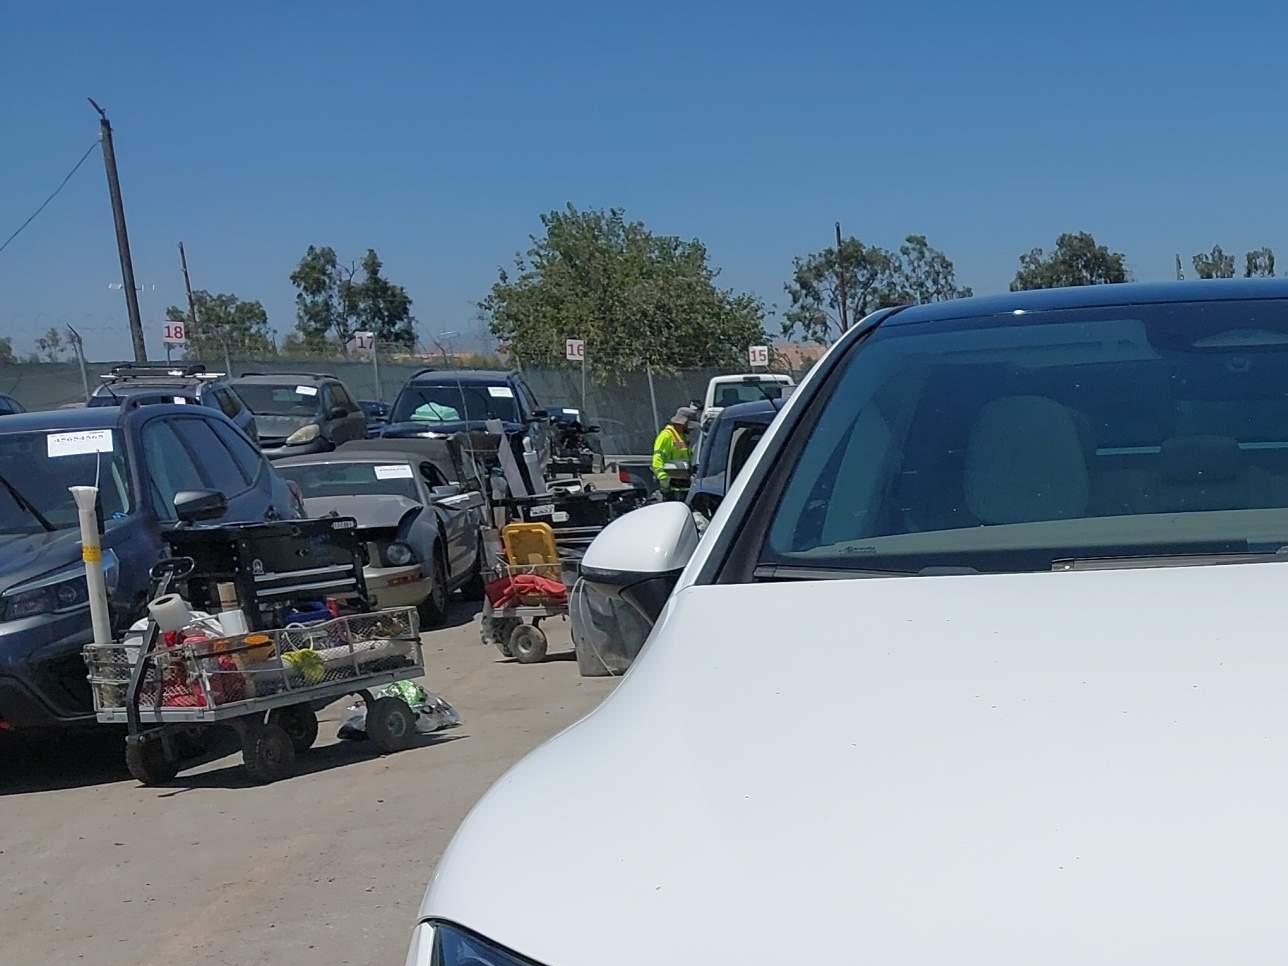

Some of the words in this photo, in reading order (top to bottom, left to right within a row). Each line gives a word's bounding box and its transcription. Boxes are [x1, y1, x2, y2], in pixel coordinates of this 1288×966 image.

[164, 324, 183, 339] 18
[357, 335, 374, 349] 17
[567, 343, 584, 357] 16
[750, 350, 767, 362] 15
